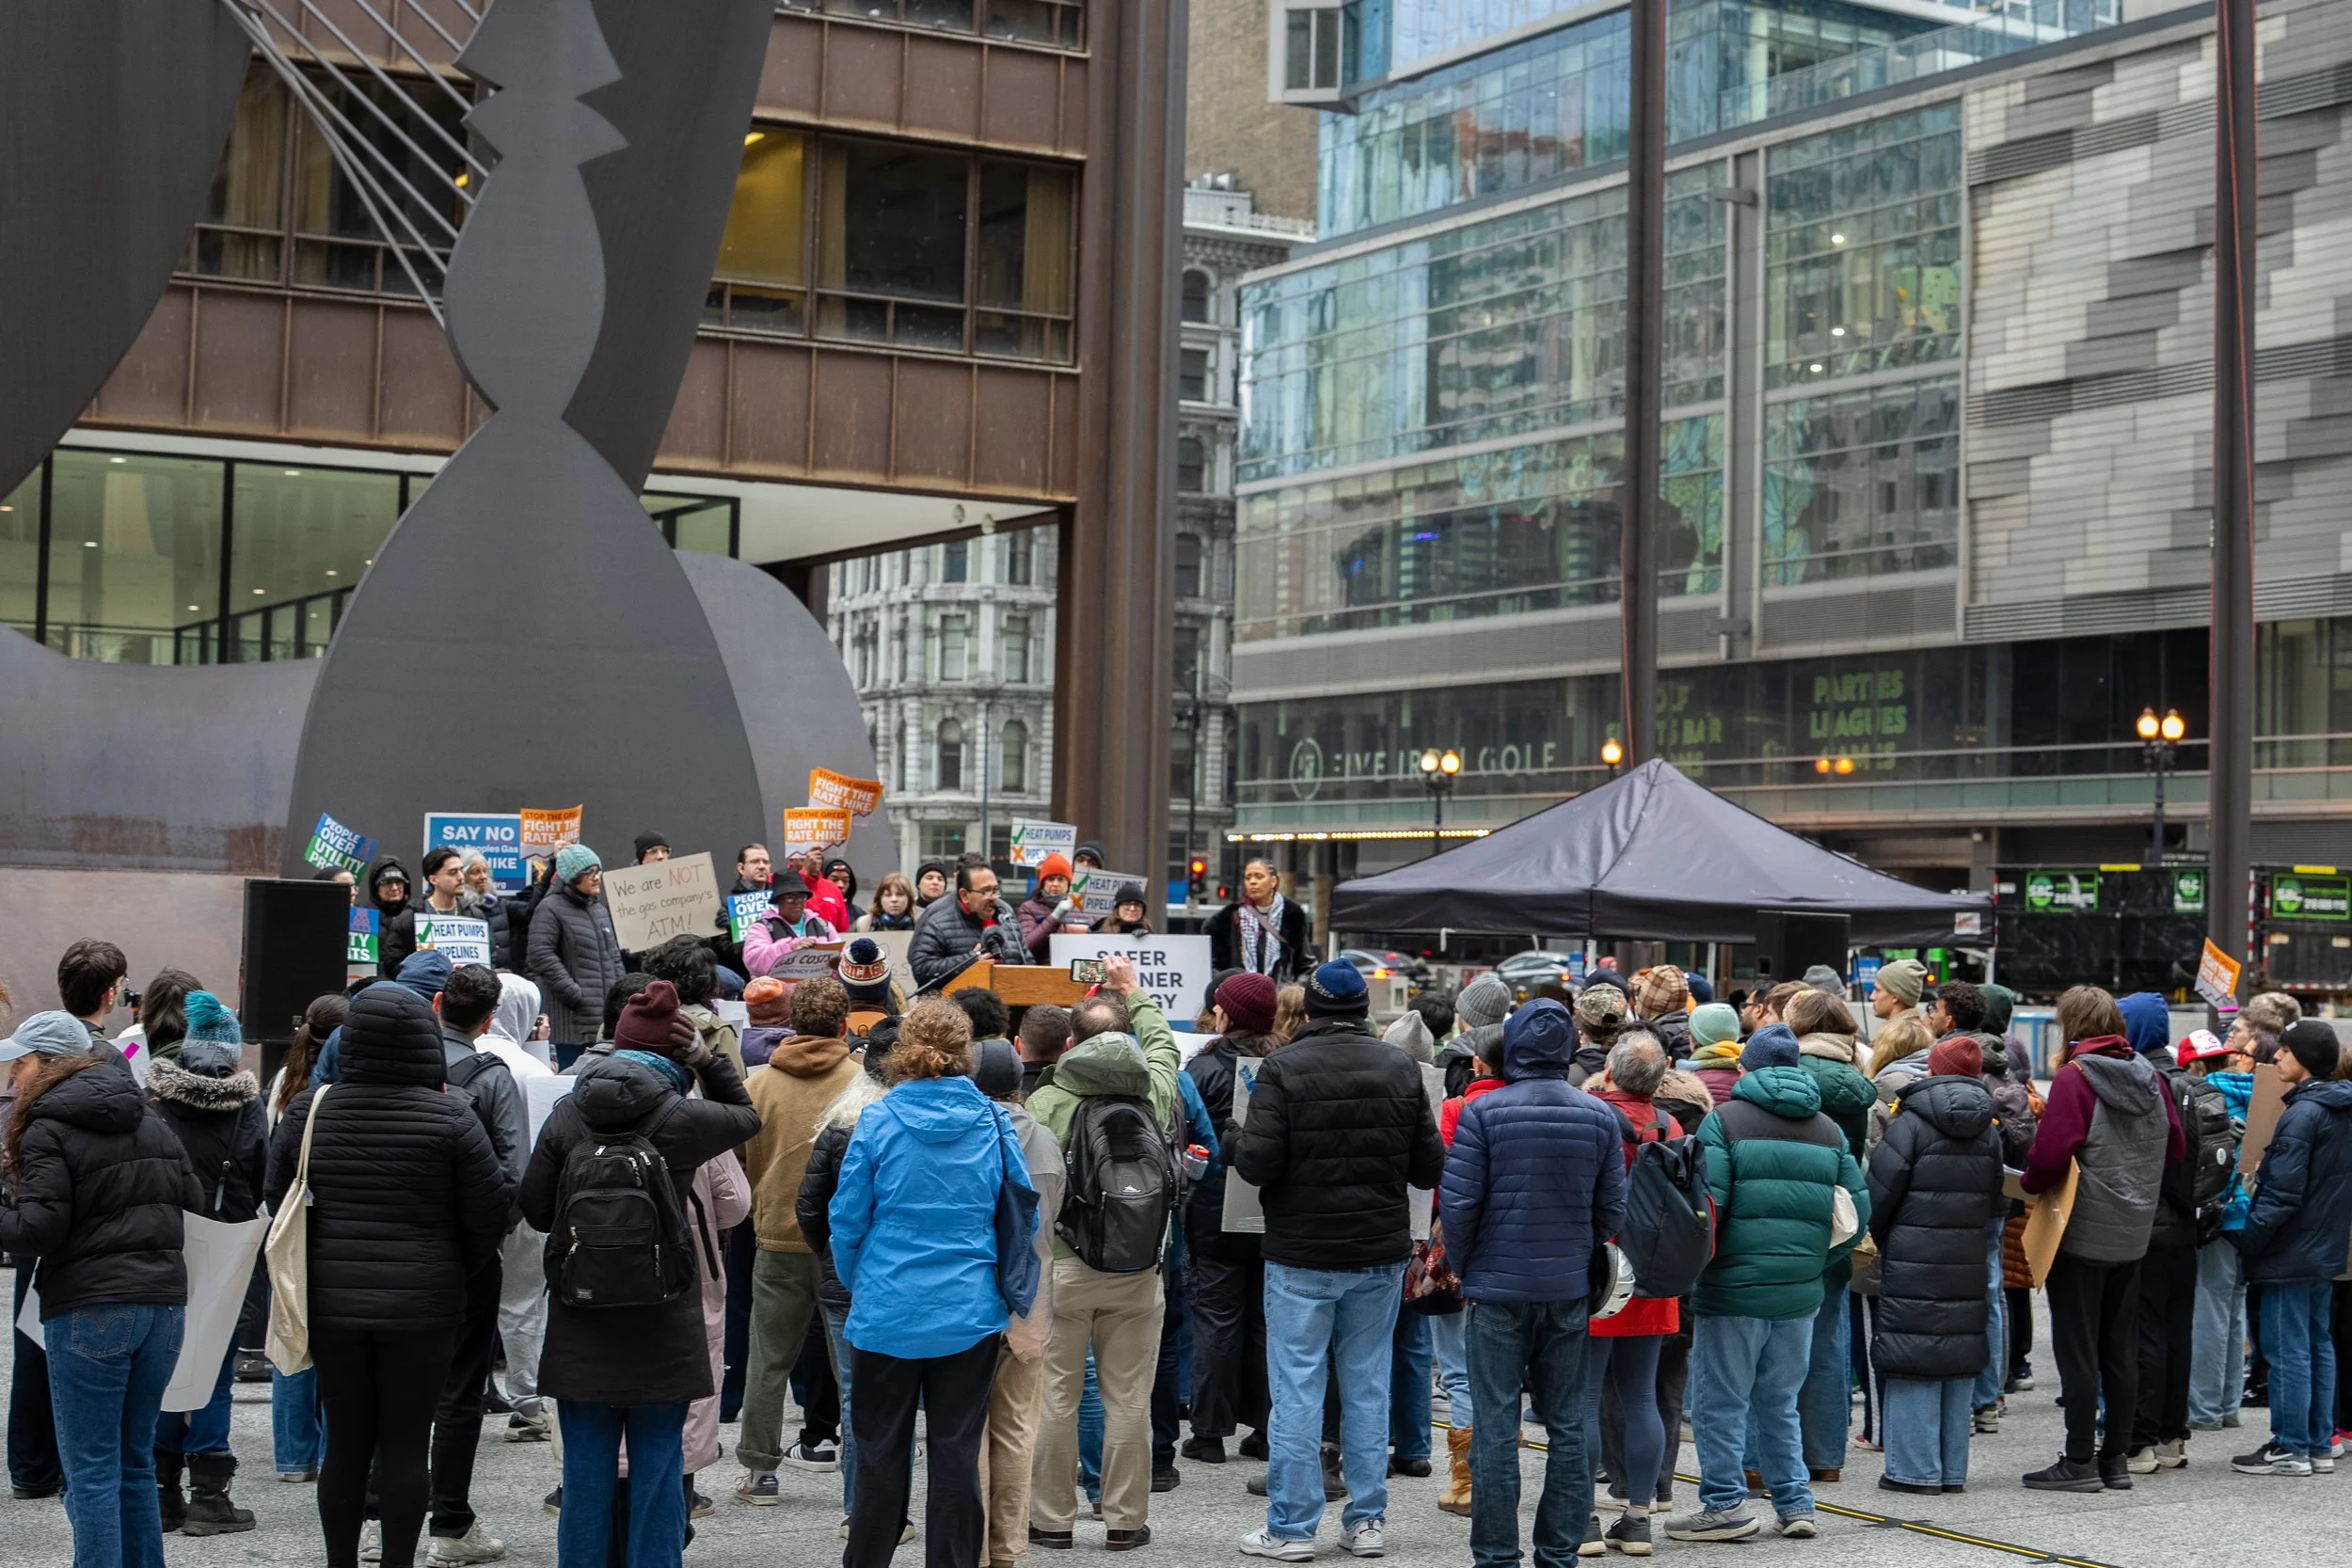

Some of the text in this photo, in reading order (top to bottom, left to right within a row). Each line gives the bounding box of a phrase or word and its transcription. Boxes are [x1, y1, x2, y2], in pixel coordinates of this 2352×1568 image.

[1814, 670, 1904, 704] PARTES
[1398, 747, 1465, 782] IR
[1478, 742, 1556, 777] GOLF
[816, 778, 874, 802] FIGHT THE
[819, 770, 879, 793] STOP THE GREED
[814, 788, 841, 806] RATE
[548, 812, 563, 820] THE
[787, 819, 844, 830] FIGHT THE
[325, 816, 360, 845] PEOPLE
[442, 826, 515, 842] SAY NO
[524, 819, 580, 832] FIGHT THE
[321, 826, 356, 855] OVER
[524, 832, 555, 844] RATE
[787, 831, 813, 841] RATE
[1025, 829, 1072, 841] HEAT PUMPS
[314, 837, 365, 874] UTILITY
[501, 845, 518, 854] Gas
[613, 864, 705, 897] We are NOT
[1089, 878, 1109, 890] HEAT
[616, 890, 713, 919] the gas company's
[1086, 898, 1116, 910] PIPELI
[434, 925, 485, 938] HEAT PUMPS
[647, 911, 691, 941] ATM!
[437, 945, 479, 959] PIPELINES
[842, 961, 885, 979] HICAGO
